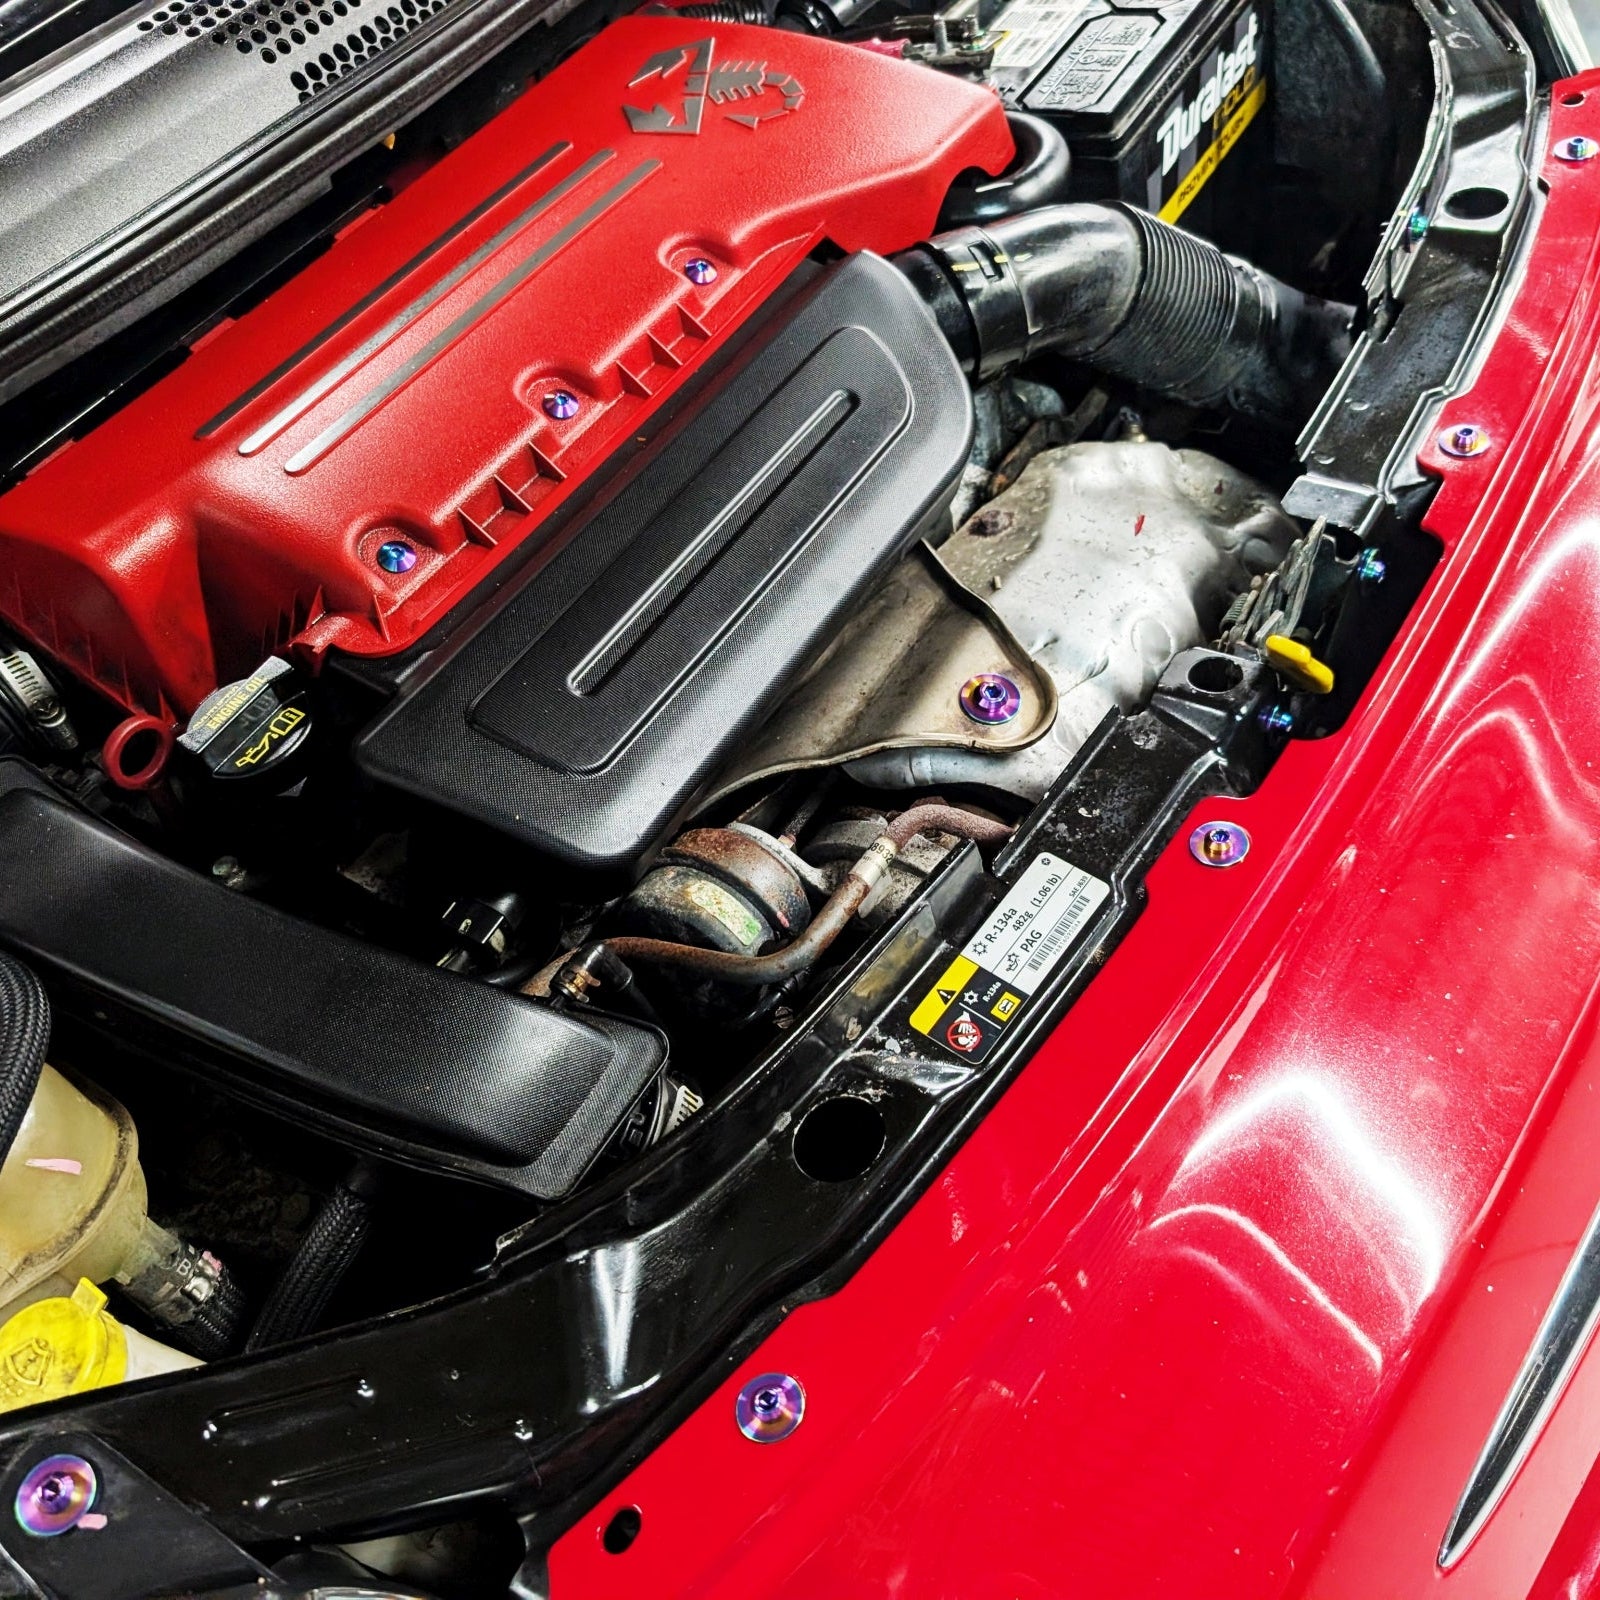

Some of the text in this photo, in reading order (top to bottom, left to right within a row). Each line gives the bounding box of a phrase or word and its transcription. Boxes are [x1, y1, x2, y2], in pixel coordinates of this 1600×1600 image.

[1156, 13, 1258, 176] Duralast
[206, 692, 249, 729] ENGINE
[246, 676, 269, 692] OIL
[870, 842, 894, 864] 8932
[1012, 873, 1062, 931] 482g (1.06 lb)
[1068, 886, 1080, 898] SAE
[985, 907, 1018, 943] R-134a
[1020, 929, 1043, 952] PAG
[982, 981, 1002, 1002] R-134a
[175, 1257, 191, 1275] B
